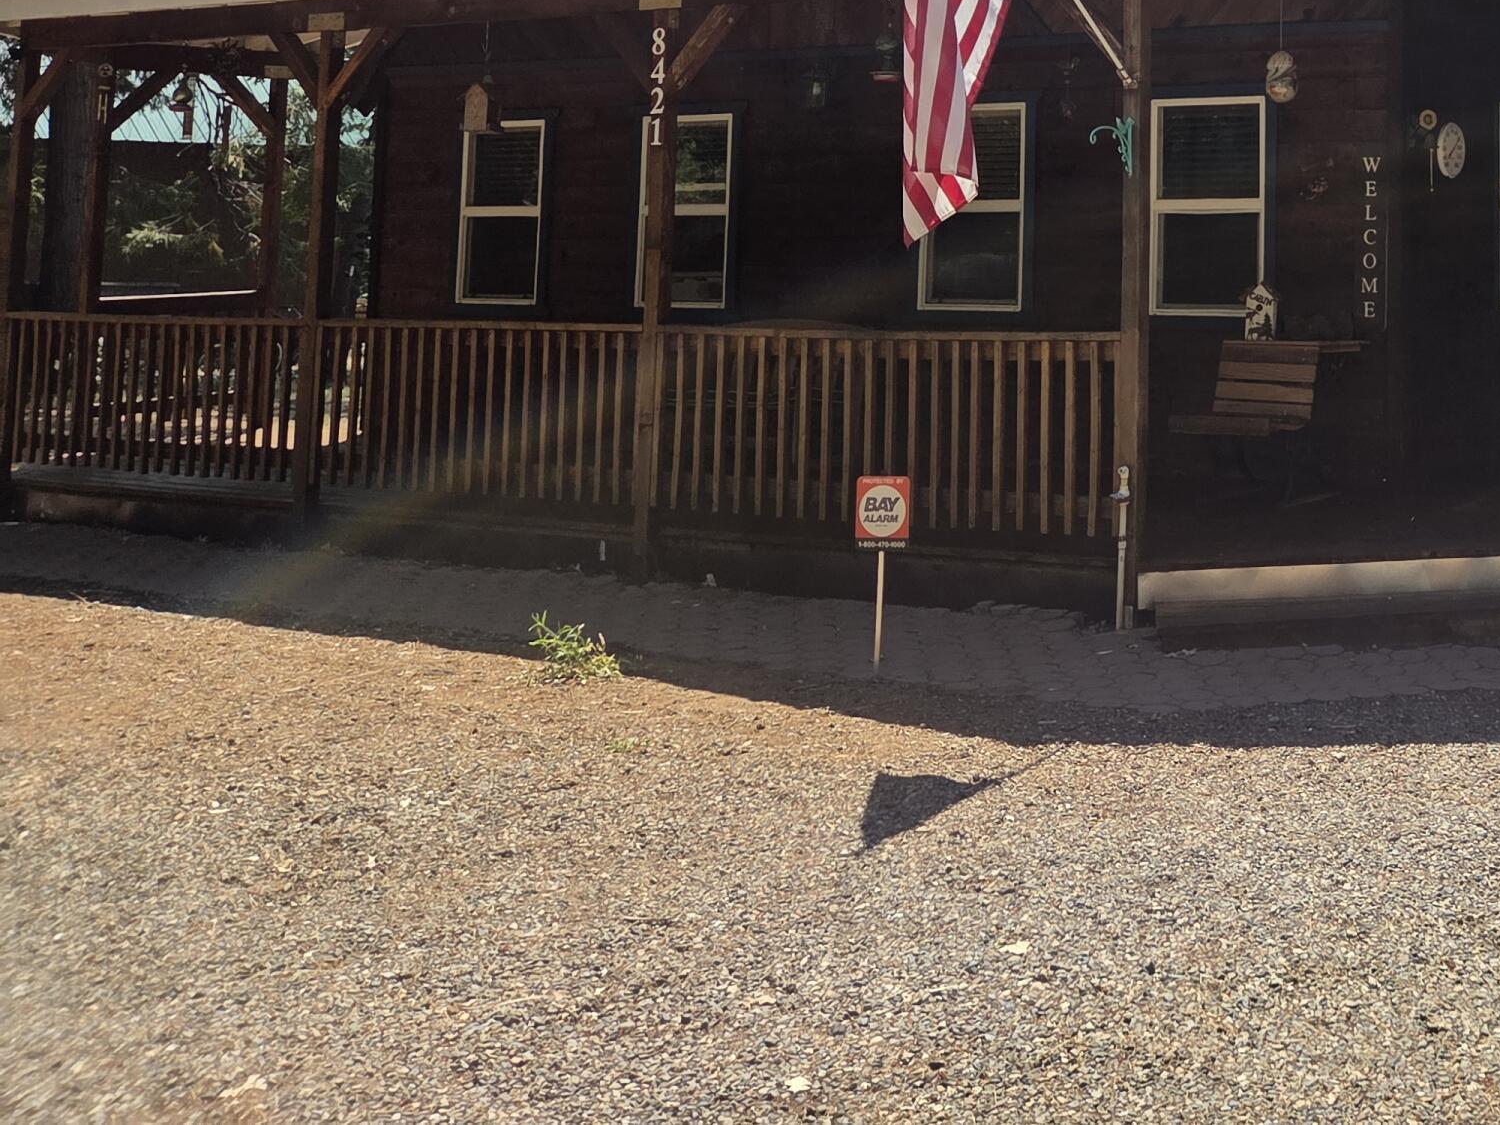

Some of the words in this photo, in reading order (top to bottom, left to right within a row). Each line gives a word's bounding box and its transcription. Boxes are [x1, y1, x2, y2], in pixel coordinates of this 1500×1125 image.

[650, 27, 666, 146] 8421
[1361, 156, 1381, 318] WELCOME
[863, 514, 898, 523] ALARM
[864, 497, 900, 512] BAY
